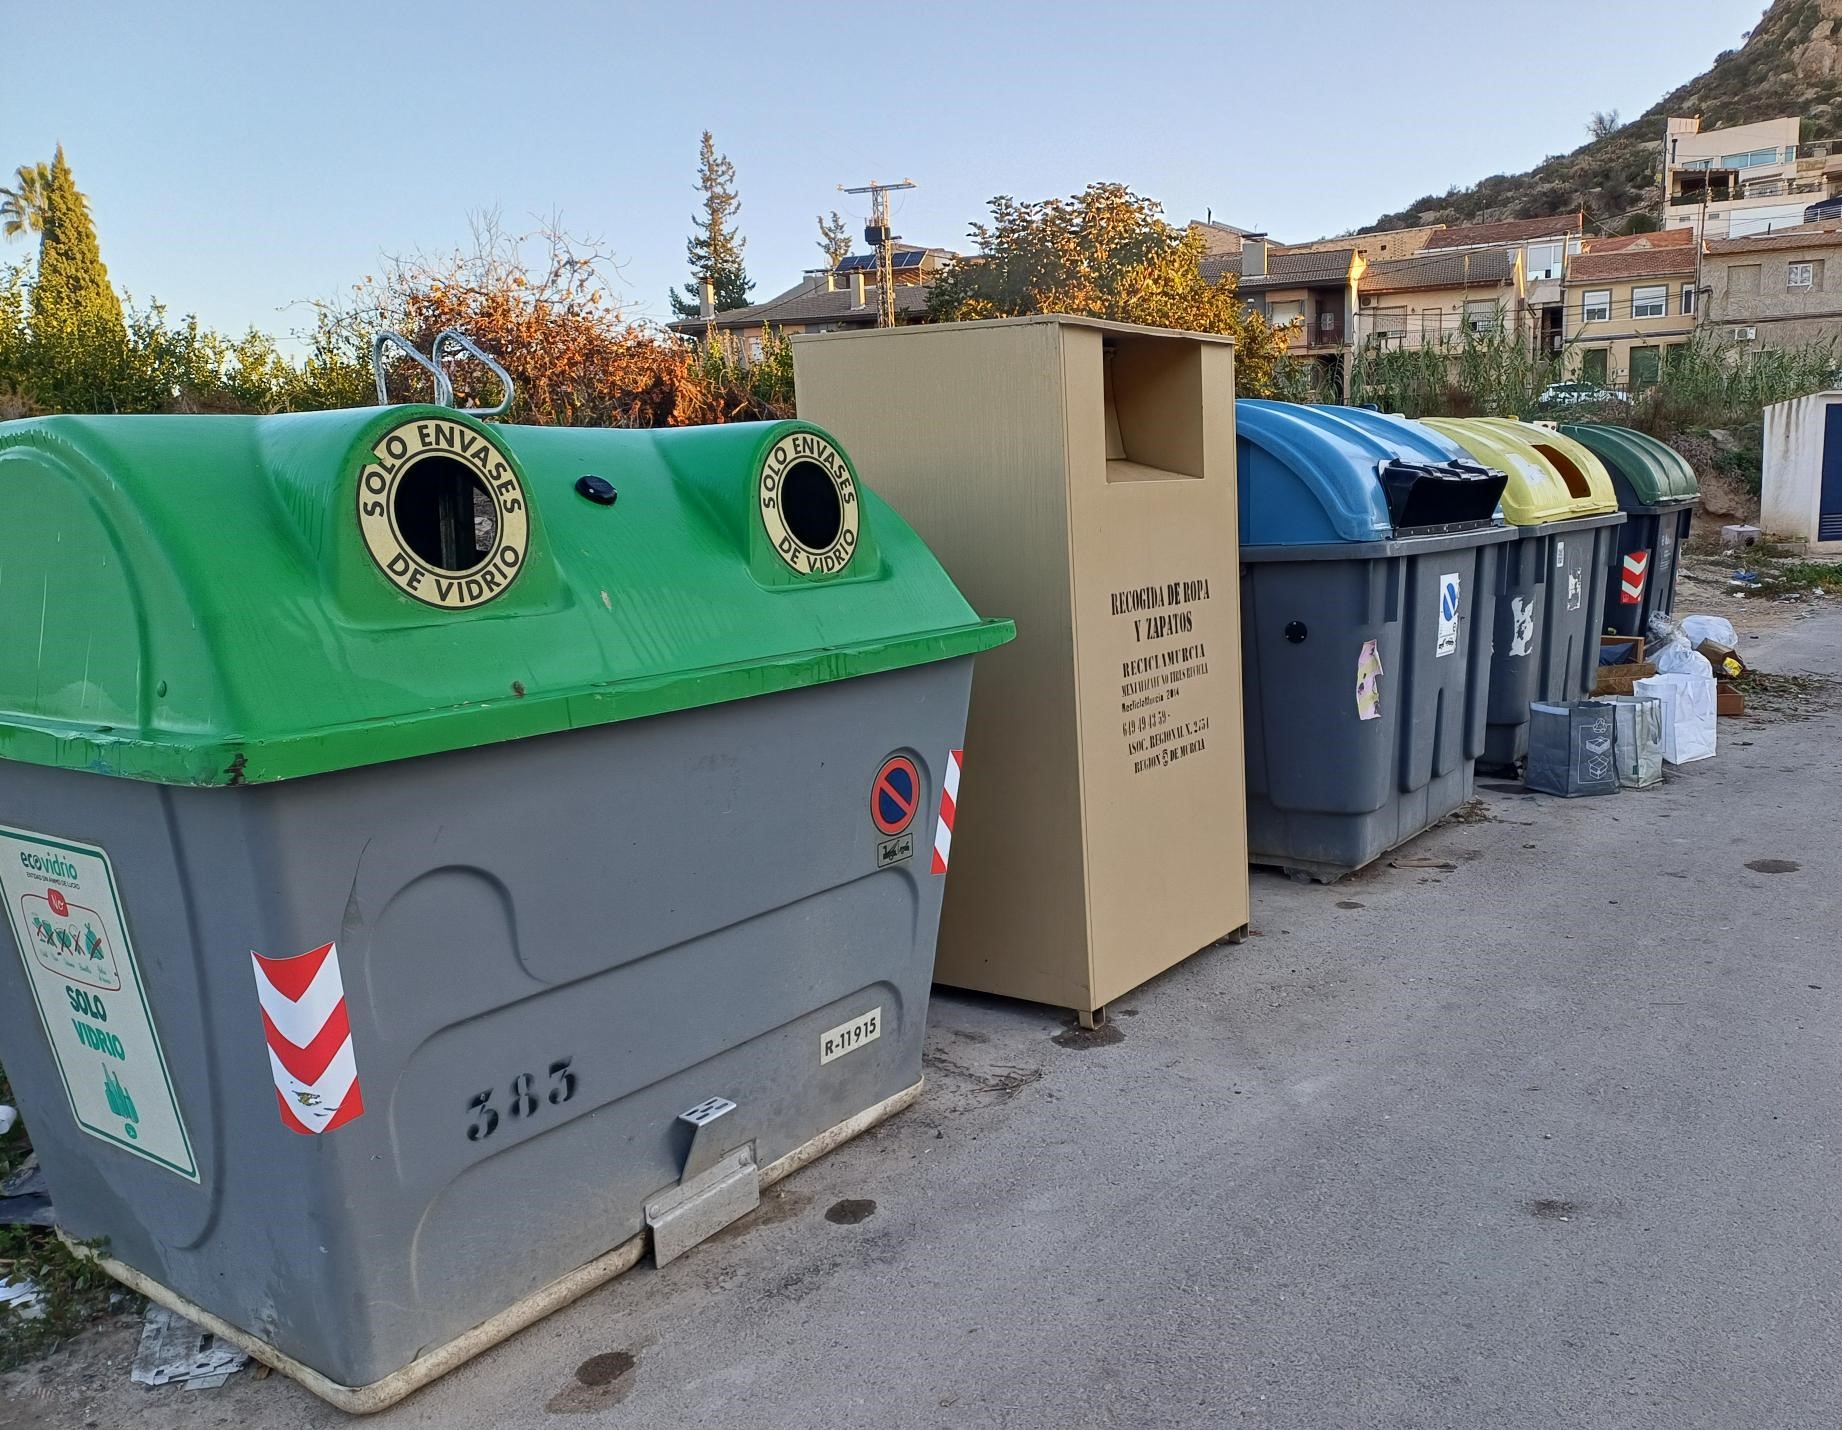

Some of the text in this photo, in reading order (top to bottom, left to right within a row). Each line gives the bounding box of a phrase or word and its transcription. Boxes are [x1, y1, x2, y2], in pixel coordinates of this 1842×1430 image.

[363, 423, 522, 518] SOLO ENVASES
[763, 436, 855, 509] SOLO ENVASES
[778, 529, 855, 573] DE VIDRIO
[386, 545, 520, 603] DE VIDRIO
[1110, 578, 1210, 616] RECOGIDA DE ROPA
[1134, 610, 1193, 642] Y ZAPATOS
[1134, 738, 1206, 774] REGION DE MURCIA
[20, 851, 78, 881] ecovidrio
[65, 984, 107, 1023] SOLO
[71, 1017, 126, 1062] VIDRIO
[825, 1016, 877, 1057] R-11915
[466, 1055, 579, 1142] 383
